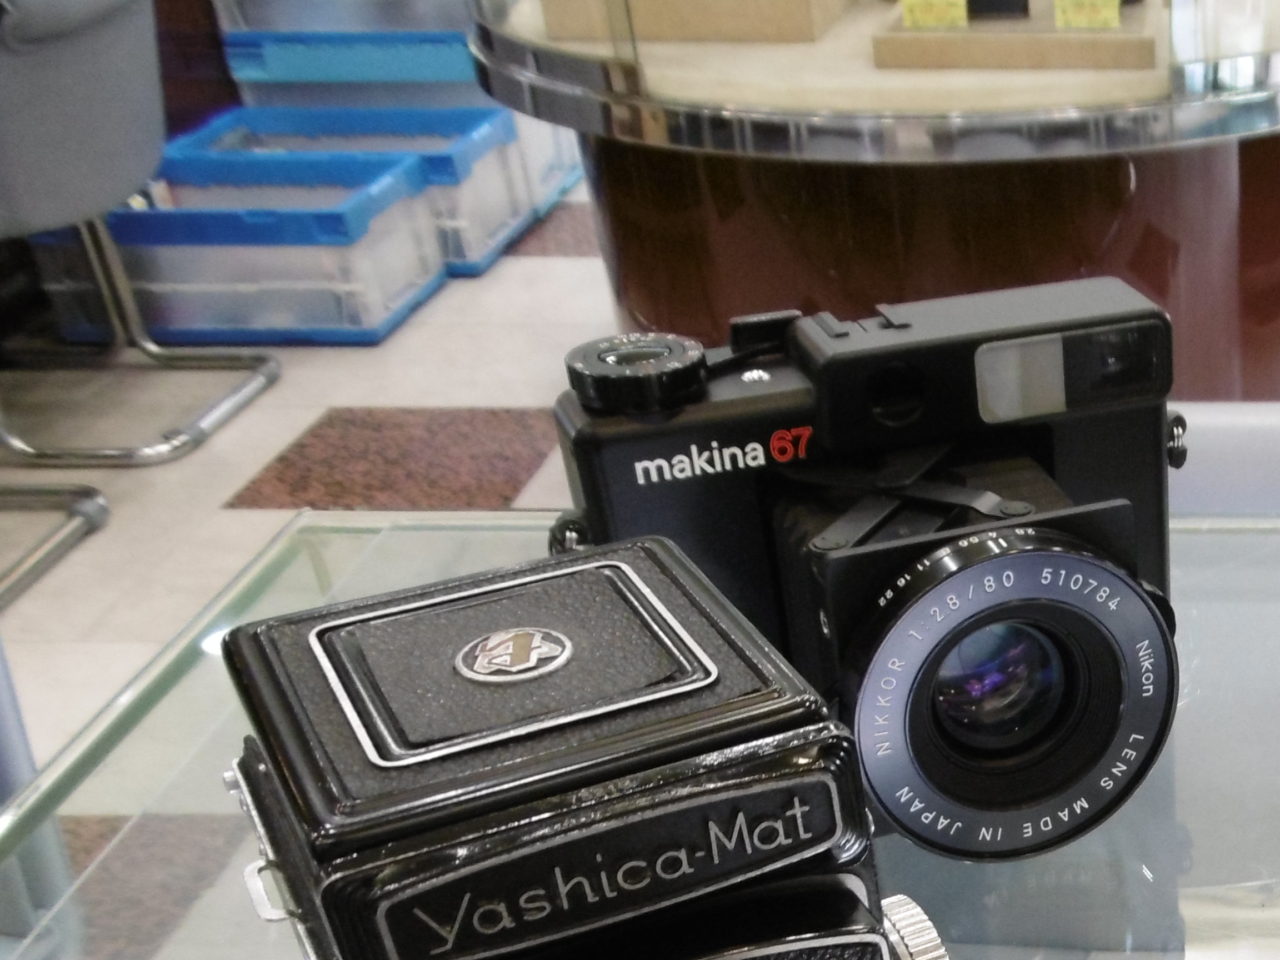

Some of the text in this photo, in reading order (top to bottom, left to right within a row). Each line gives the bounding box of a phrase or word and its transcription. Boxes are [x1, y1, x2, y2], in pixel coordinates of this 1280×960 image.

[634, 426, 813, 486] makina 67
[875, 656, 906, 757] NIKKOR
[1040, 567, 1121, 612] 510784
[1136, 639, 1155, 698] Nikon
[895, 733, 1145, 842] LENS MADE IN JAPAN
[413, 795, 813, 956] Yashica-Mat
